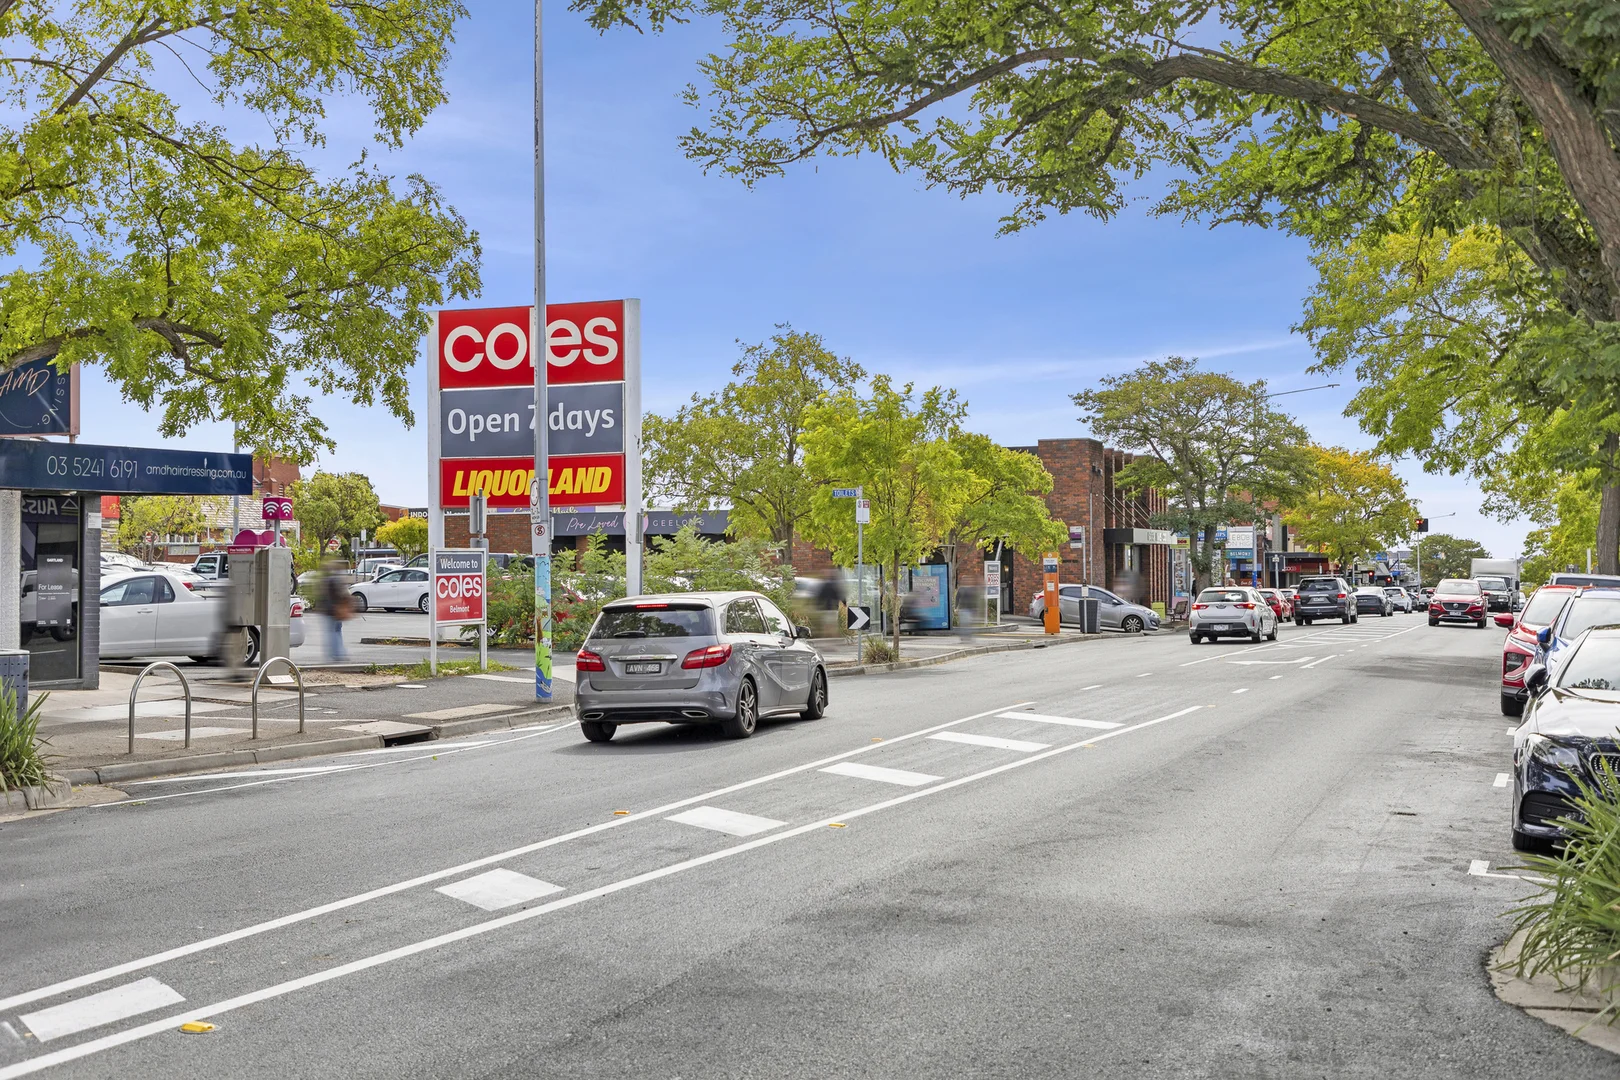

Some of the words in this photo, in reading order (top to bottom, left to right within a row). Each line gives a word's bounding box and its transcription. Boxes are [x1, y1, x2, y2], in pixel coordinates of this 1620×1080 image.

[444, 308, 618, 373] coles
[448, 408, 519, 441] Open
[549, 402, 615, 437] days
[46, 455, 68, 476] 03
[72, 457, 104, 477] 5241
[109, 459, 138, 478] 6191
[146, 464, 247, 480] amdhairdressing.com.au
[567, 517, 586, 532] Pre
[588, 515, 619, 531] Loved
[440, 558, 471, 569] Welcome
[471, 559, 479, 569] to
[437, 574, 482, 599] coles
[450, 605, 470, 613] Belmont
[629, 664, 643, 672] AVN
